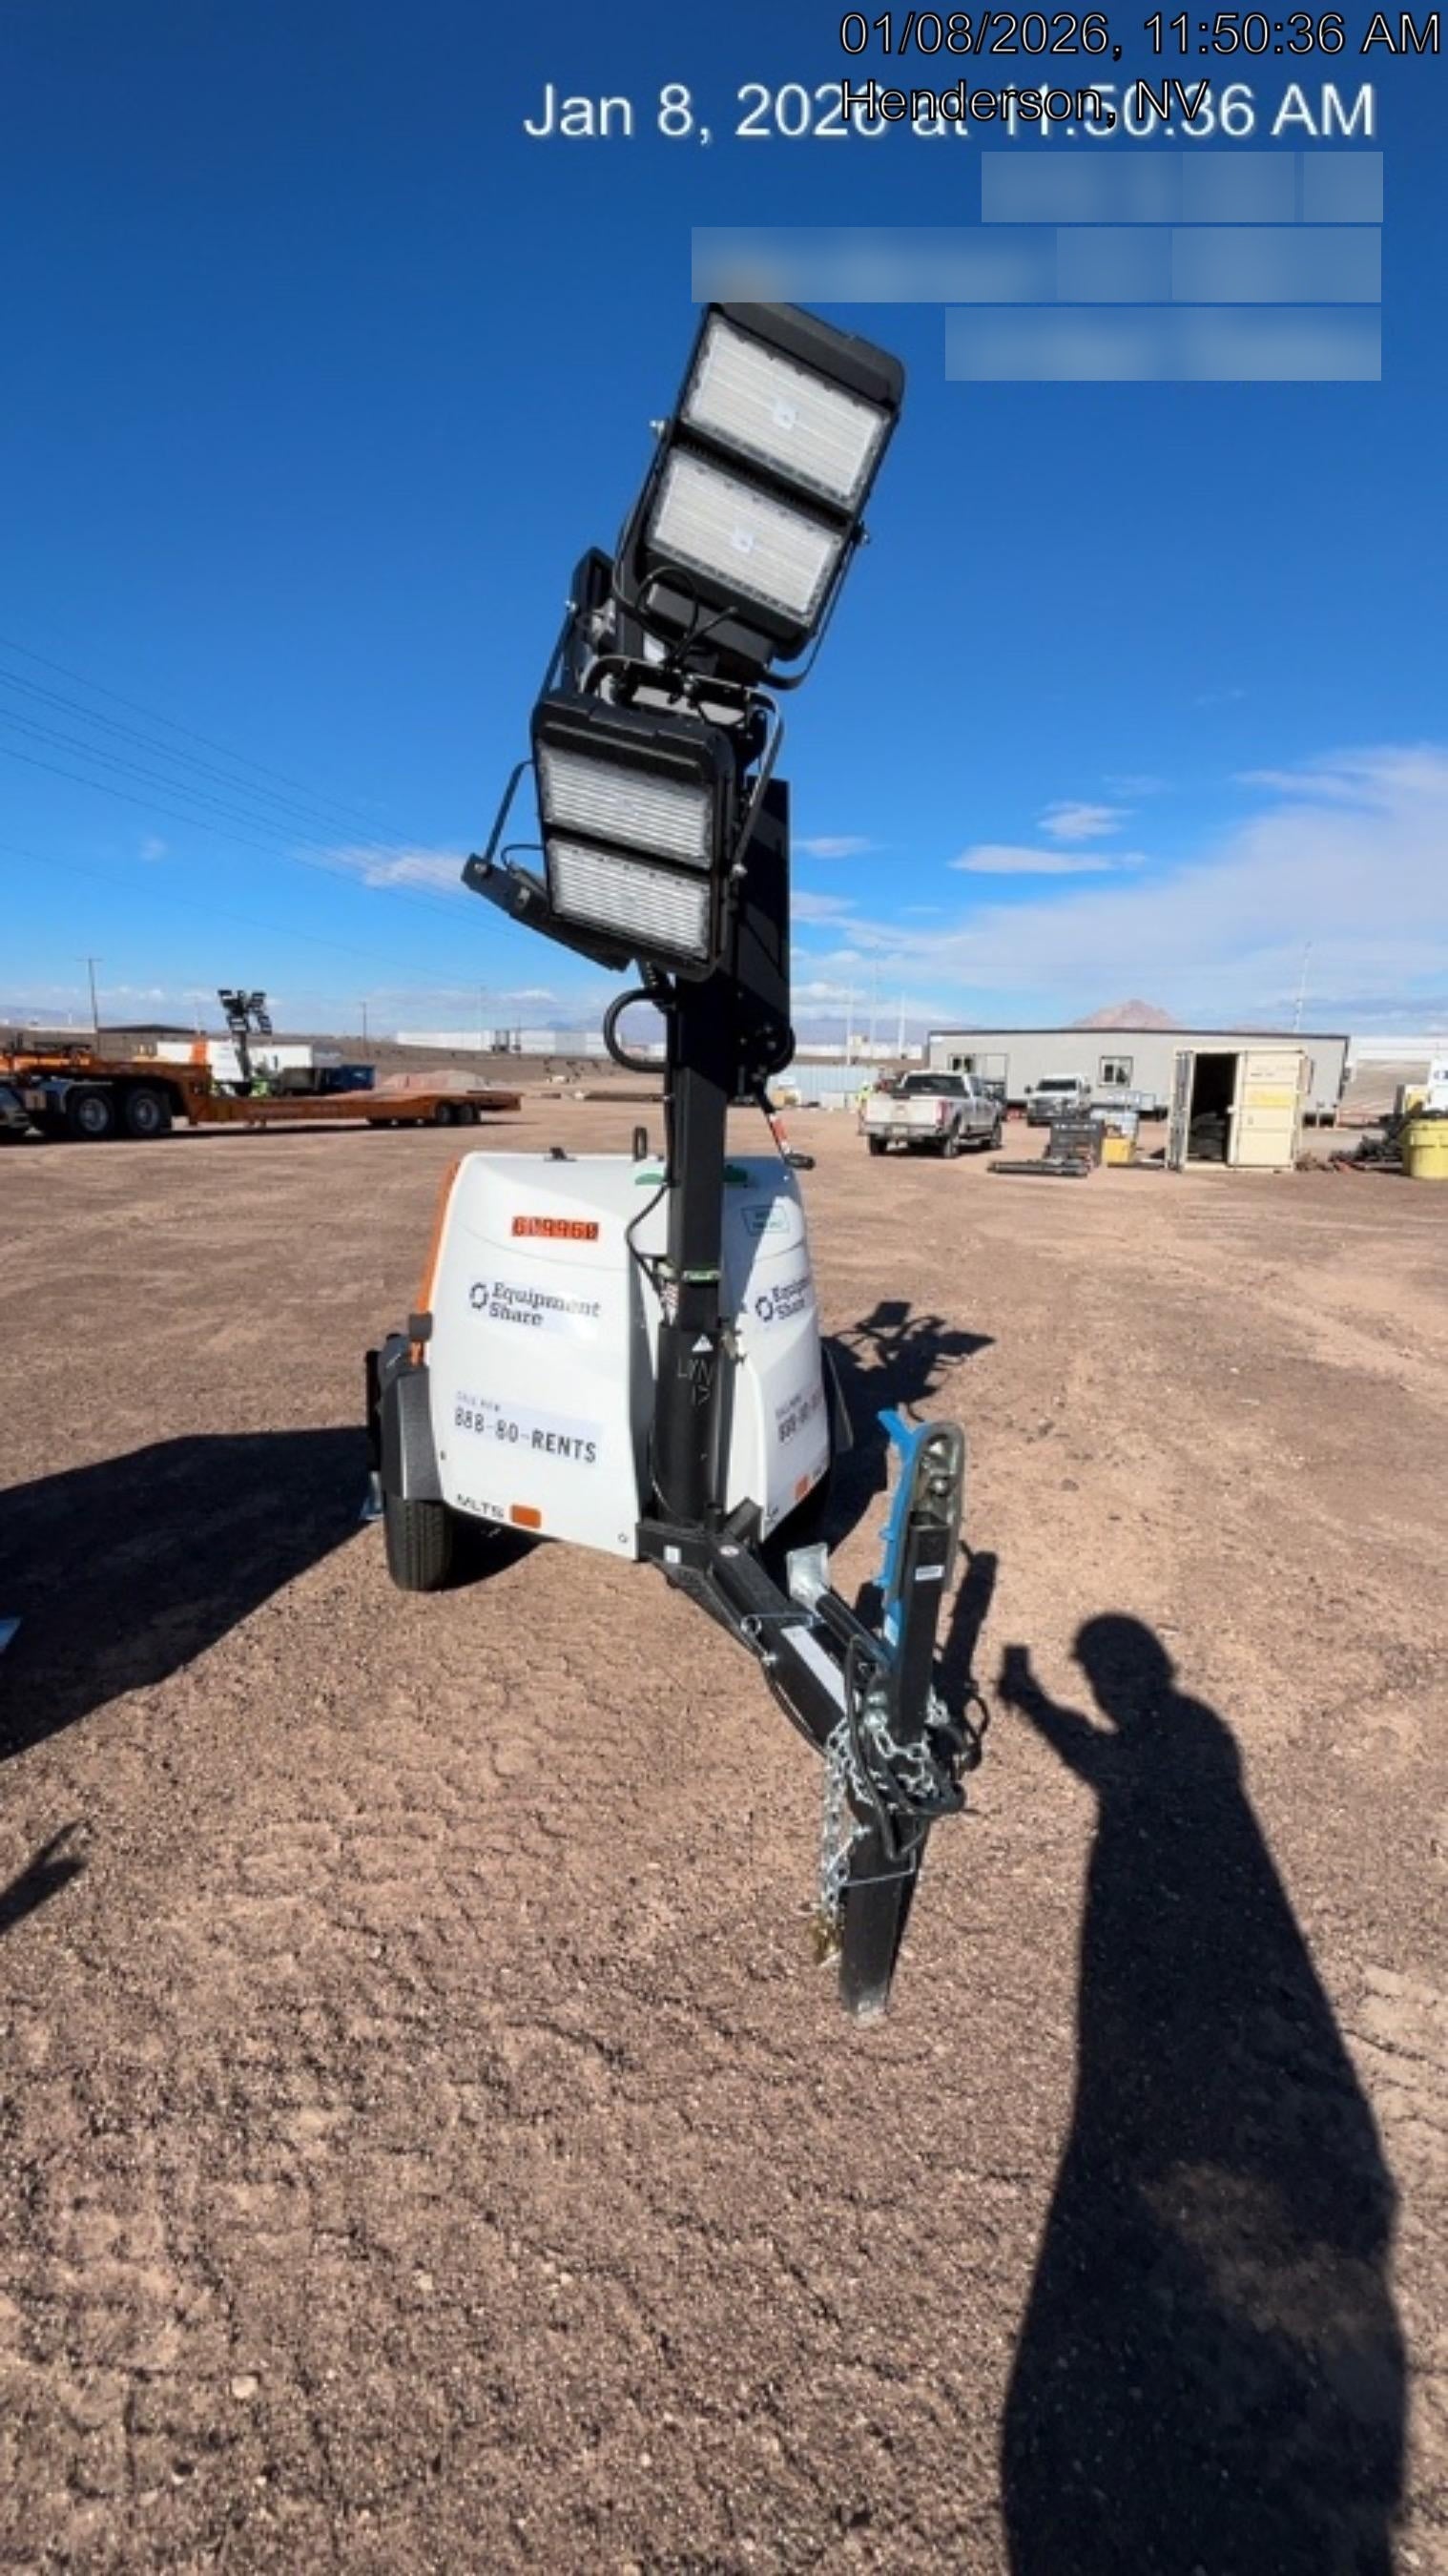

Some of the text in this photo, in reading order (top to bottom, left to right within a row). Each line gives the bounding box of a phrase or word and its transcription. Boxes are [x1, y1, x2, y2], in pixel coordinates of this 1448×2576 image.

[488, 1301, 544, 1326] Share
[491, 1280, 601, 1318] Equipment
[454, 1405, 597, 1464] 888-80-RENTS
